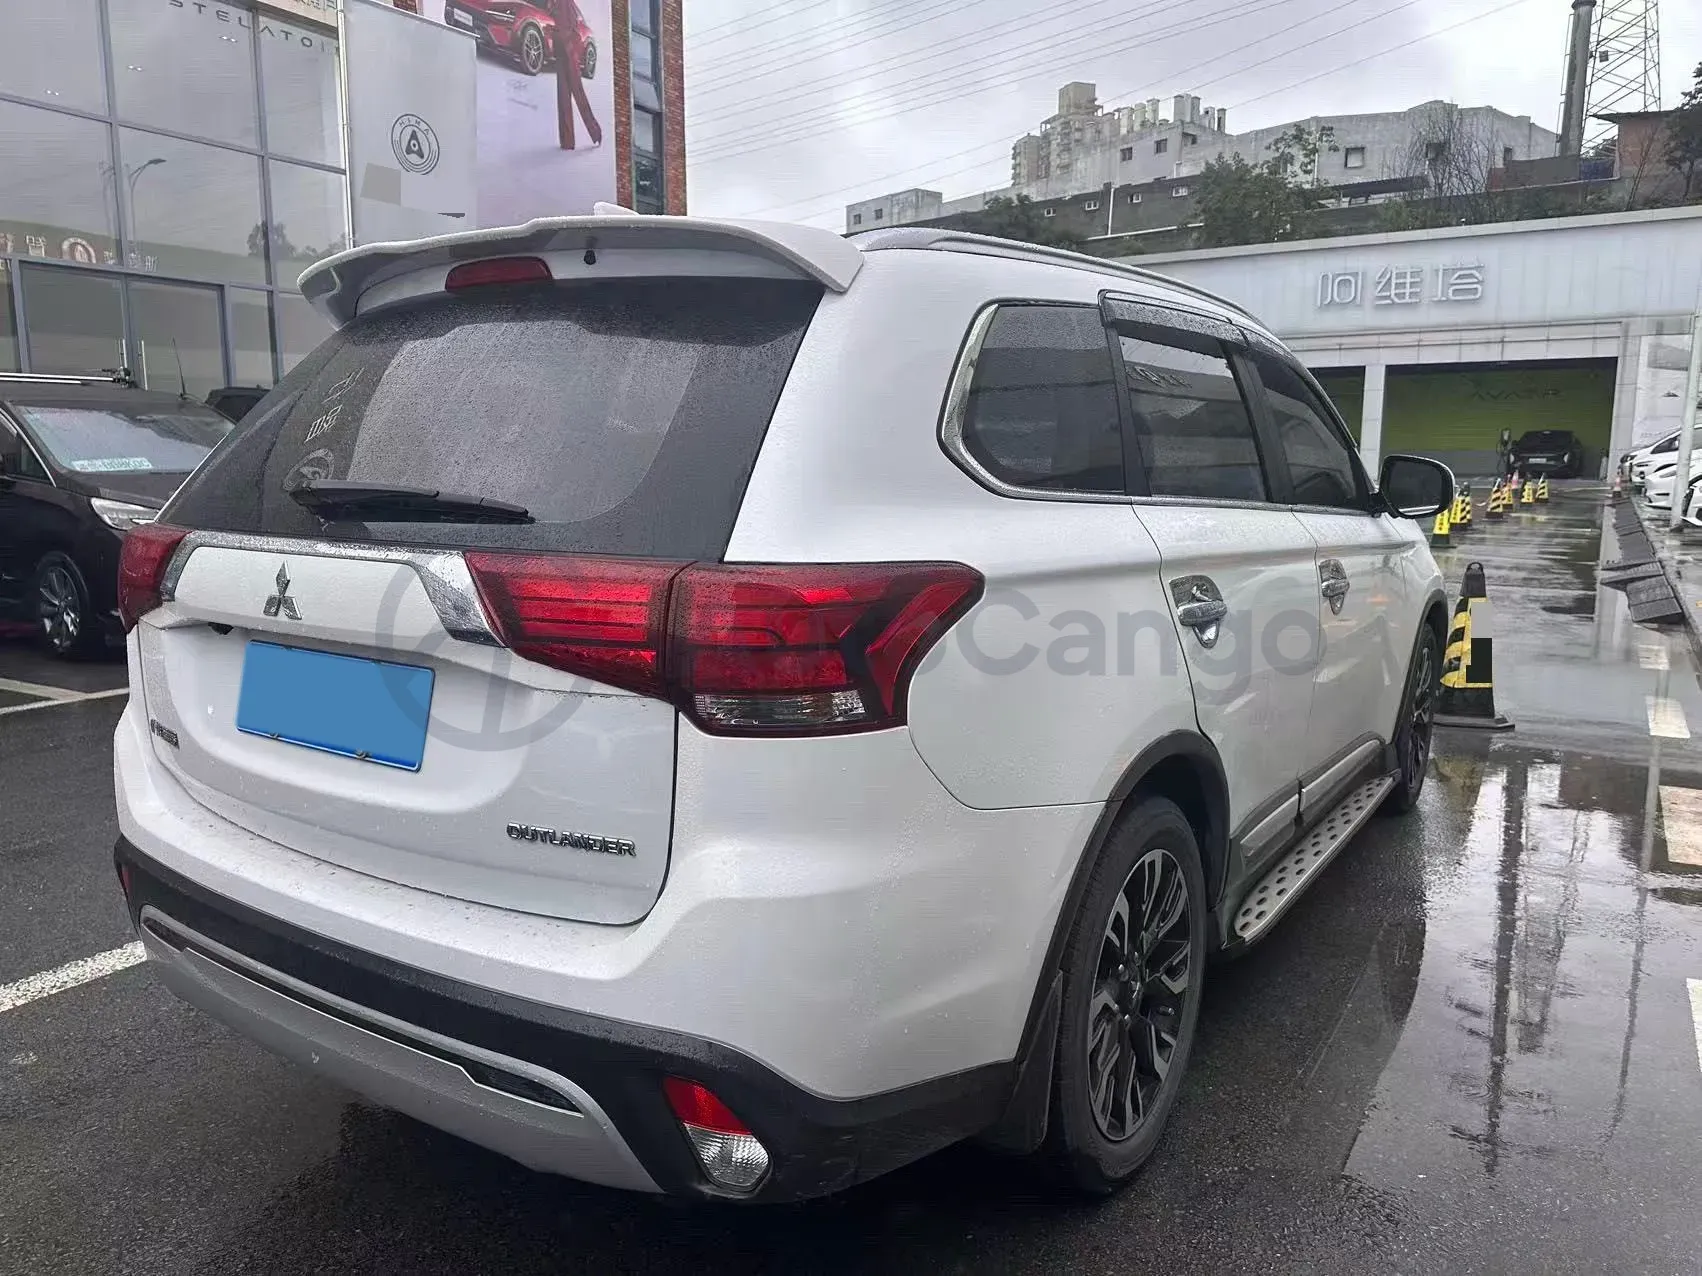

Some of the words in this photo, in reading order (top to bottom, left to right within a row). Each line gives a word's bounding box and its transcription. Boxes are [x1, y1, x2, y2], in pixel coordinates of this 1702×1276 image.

[1316, 257, 1485, 307] 阿维塔
[506, 821, 637, 857] OUTLANDER
